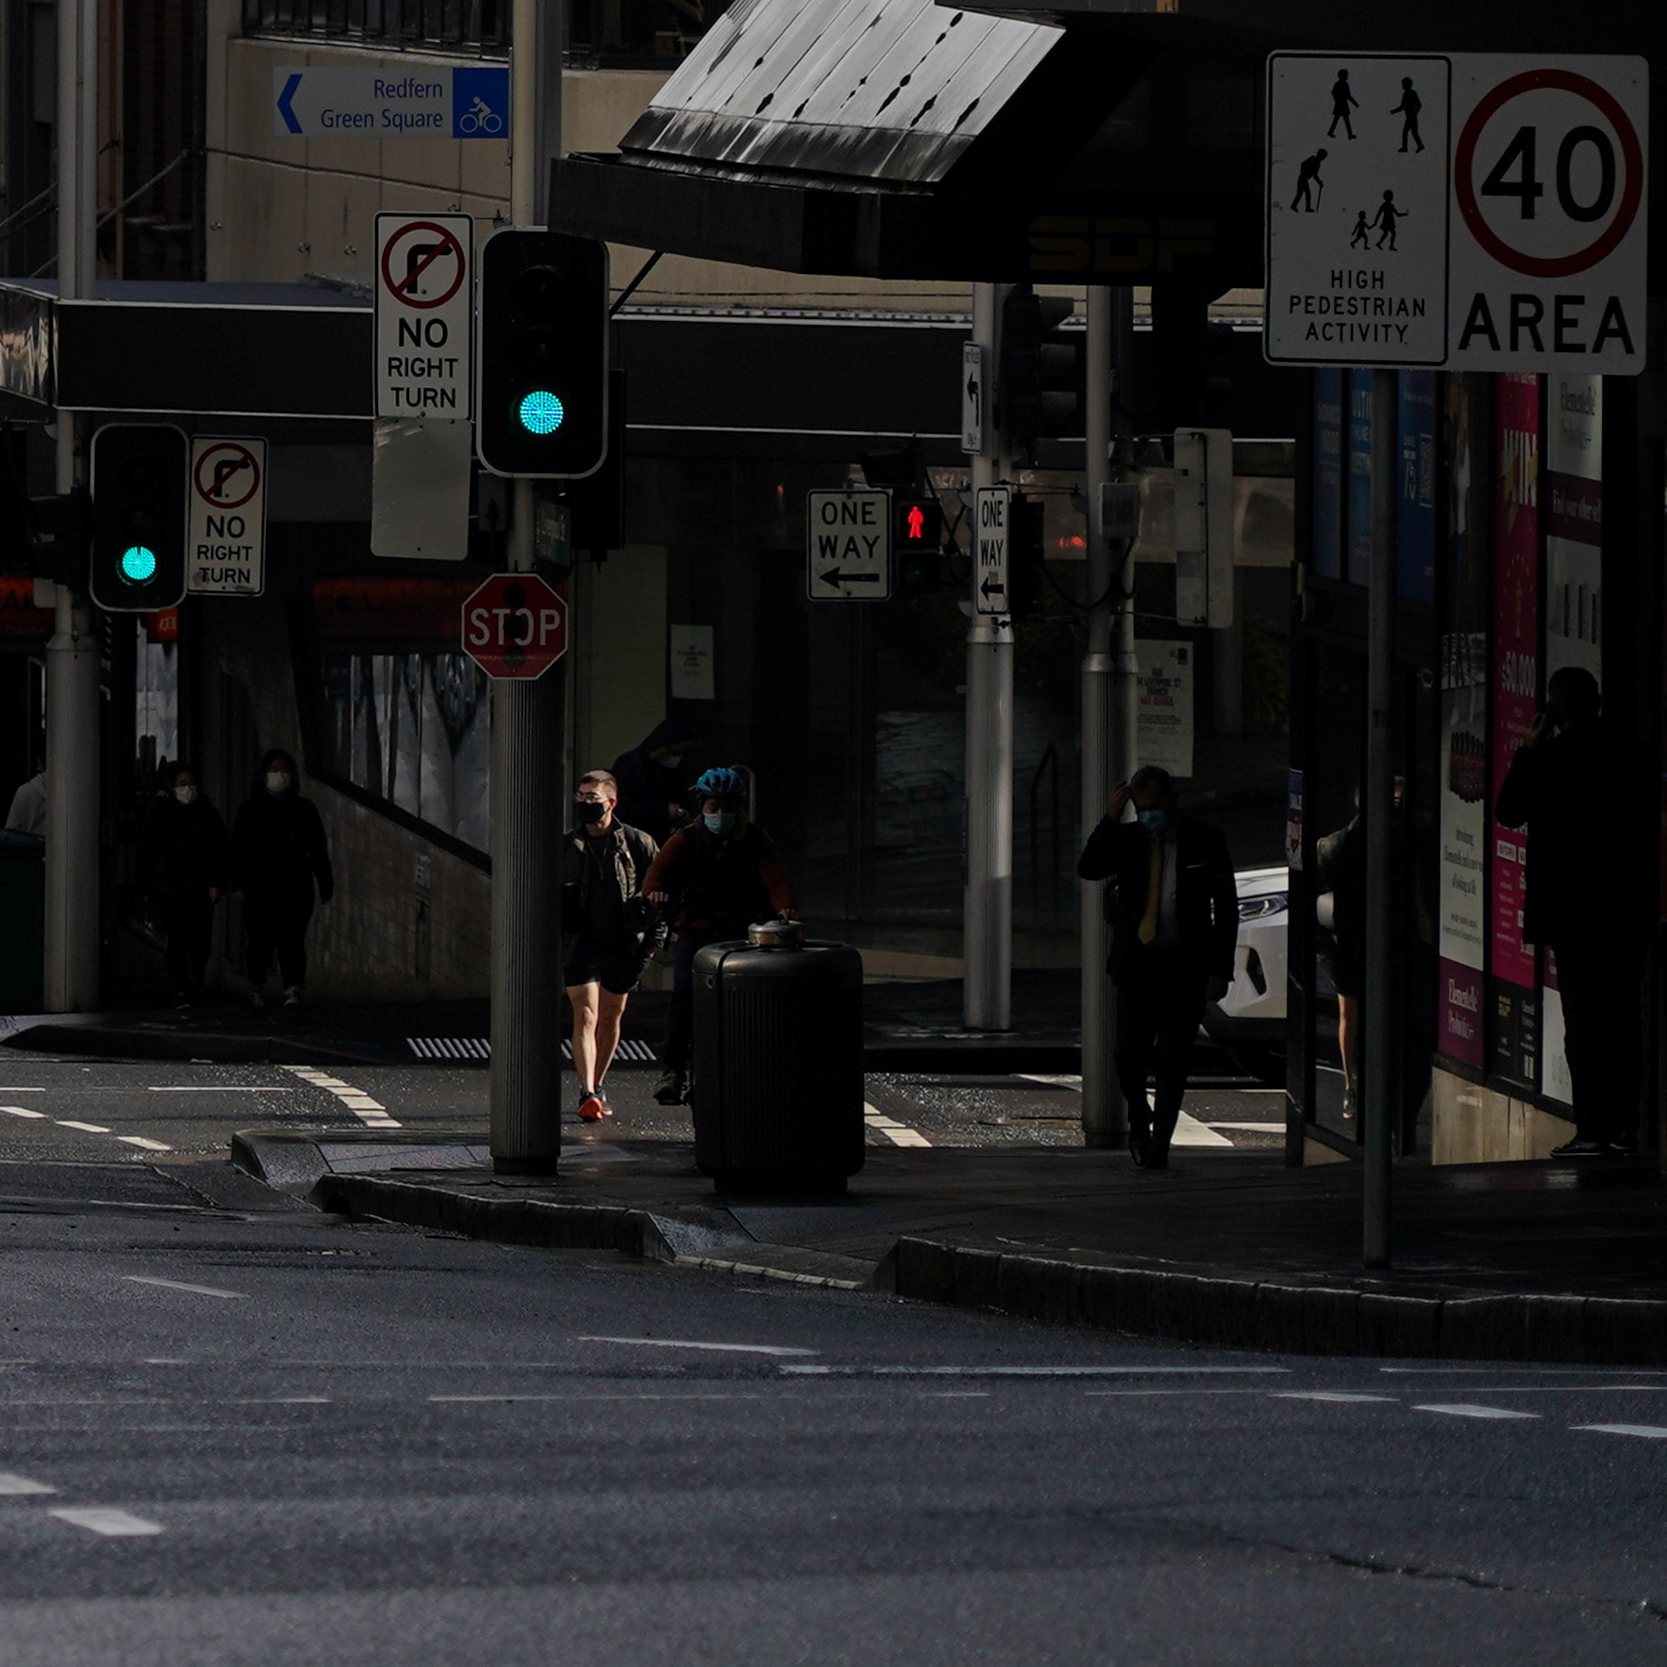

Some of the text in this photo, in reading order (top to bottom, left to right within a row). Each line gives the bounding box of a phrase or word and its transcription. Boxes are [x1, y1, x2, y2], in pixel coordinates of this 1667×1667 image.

[373, 77, 443, 98] Redfern
[321, 108, 443, 133] Green Square
[1480, 125, 1616, 222] 40
[1027, 215, 1217, 273] SDF
[1330, 269, 1385, 289] HIGH
[1289, 294, 1426, 317] PEDESTRIAN
[398, 317, 449, 348] NO
[1305, 321, 1409, 342] ACTIVITY
[1458, 292, 1635, 355] AREA
[387, 356, 459, 378] RIGHT
[390, 387, 457, 408] TURN
[1502, 426, 1538, 508] WIN
[820, 501, 877, 526] ONE
[982, 499, 1004, 528] ONE
[206, 515, 246, 538] NO
[196, 544, 253, 562] RIGHT
[818, 535, 880, 560] WAY
[980, 538, 1004, 568] WAY
[199, 567, 251, 584] TURN
[468, 607, 562, 647] STOP
